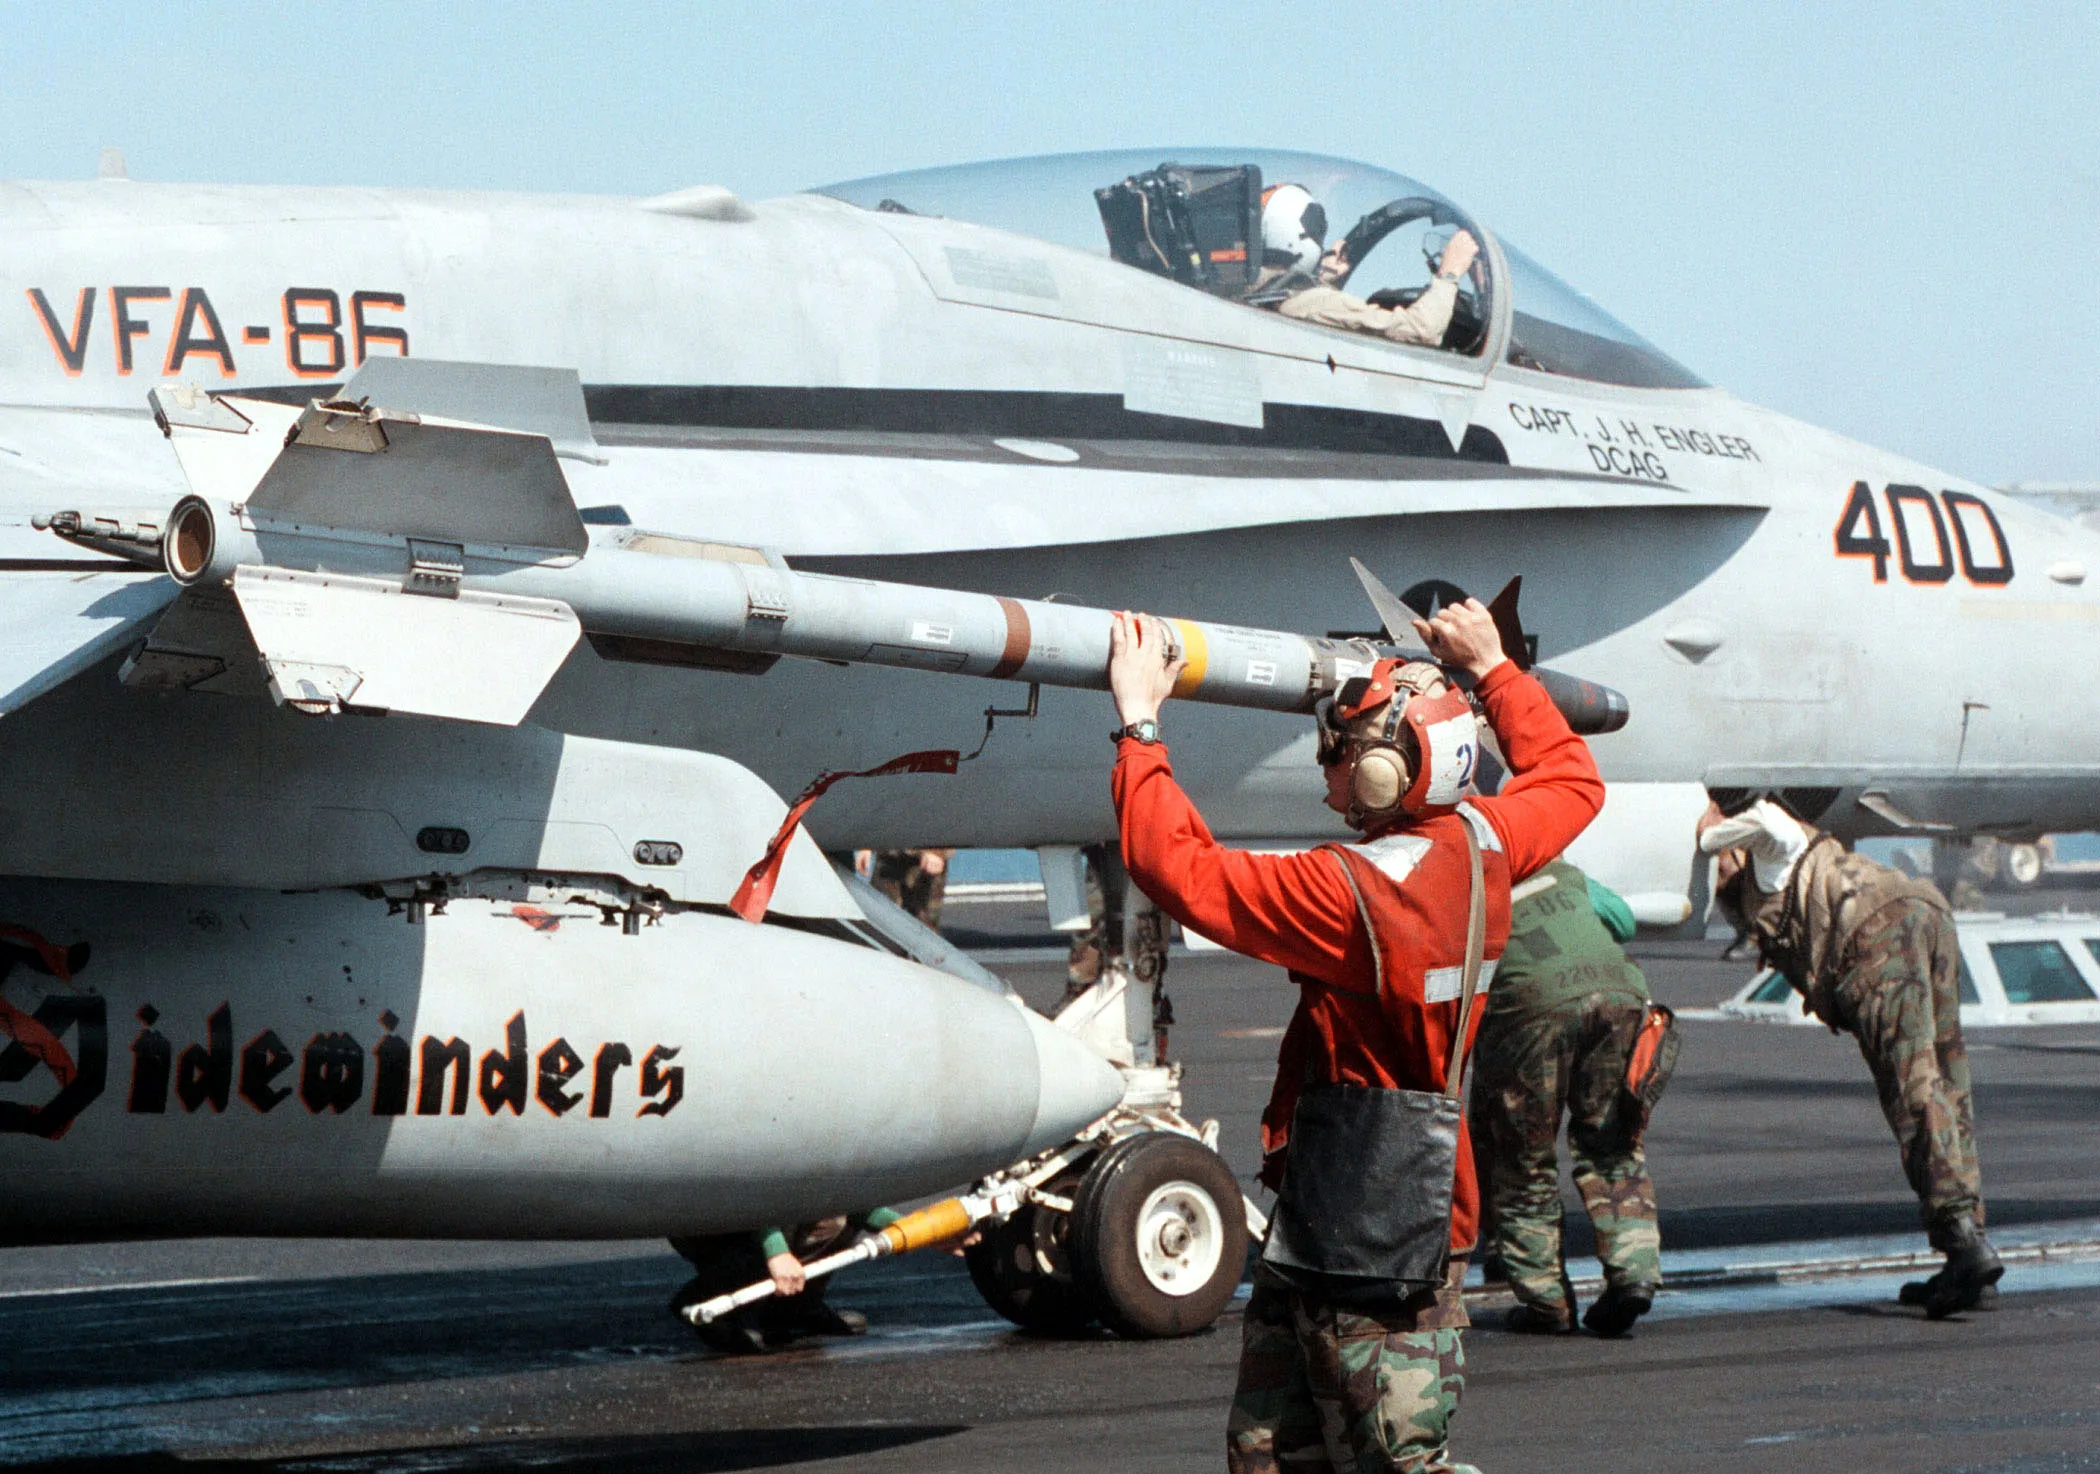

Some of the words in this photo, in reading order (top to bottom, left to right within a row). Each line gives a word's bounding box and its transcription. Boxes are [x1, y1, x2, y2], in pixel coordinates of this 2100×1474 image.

[26, 286, 409, 378] VFA-86
[1587, 444, 1668, 481] DCAG
[1596, 416, 1619, 443] J.
[1620, 419, 1653, 448] H.
[1654, 425, 1761, 463] ENGLER
[1833, 480, 2015, 588] 400
[1456, 743, 1473, 789] 2
